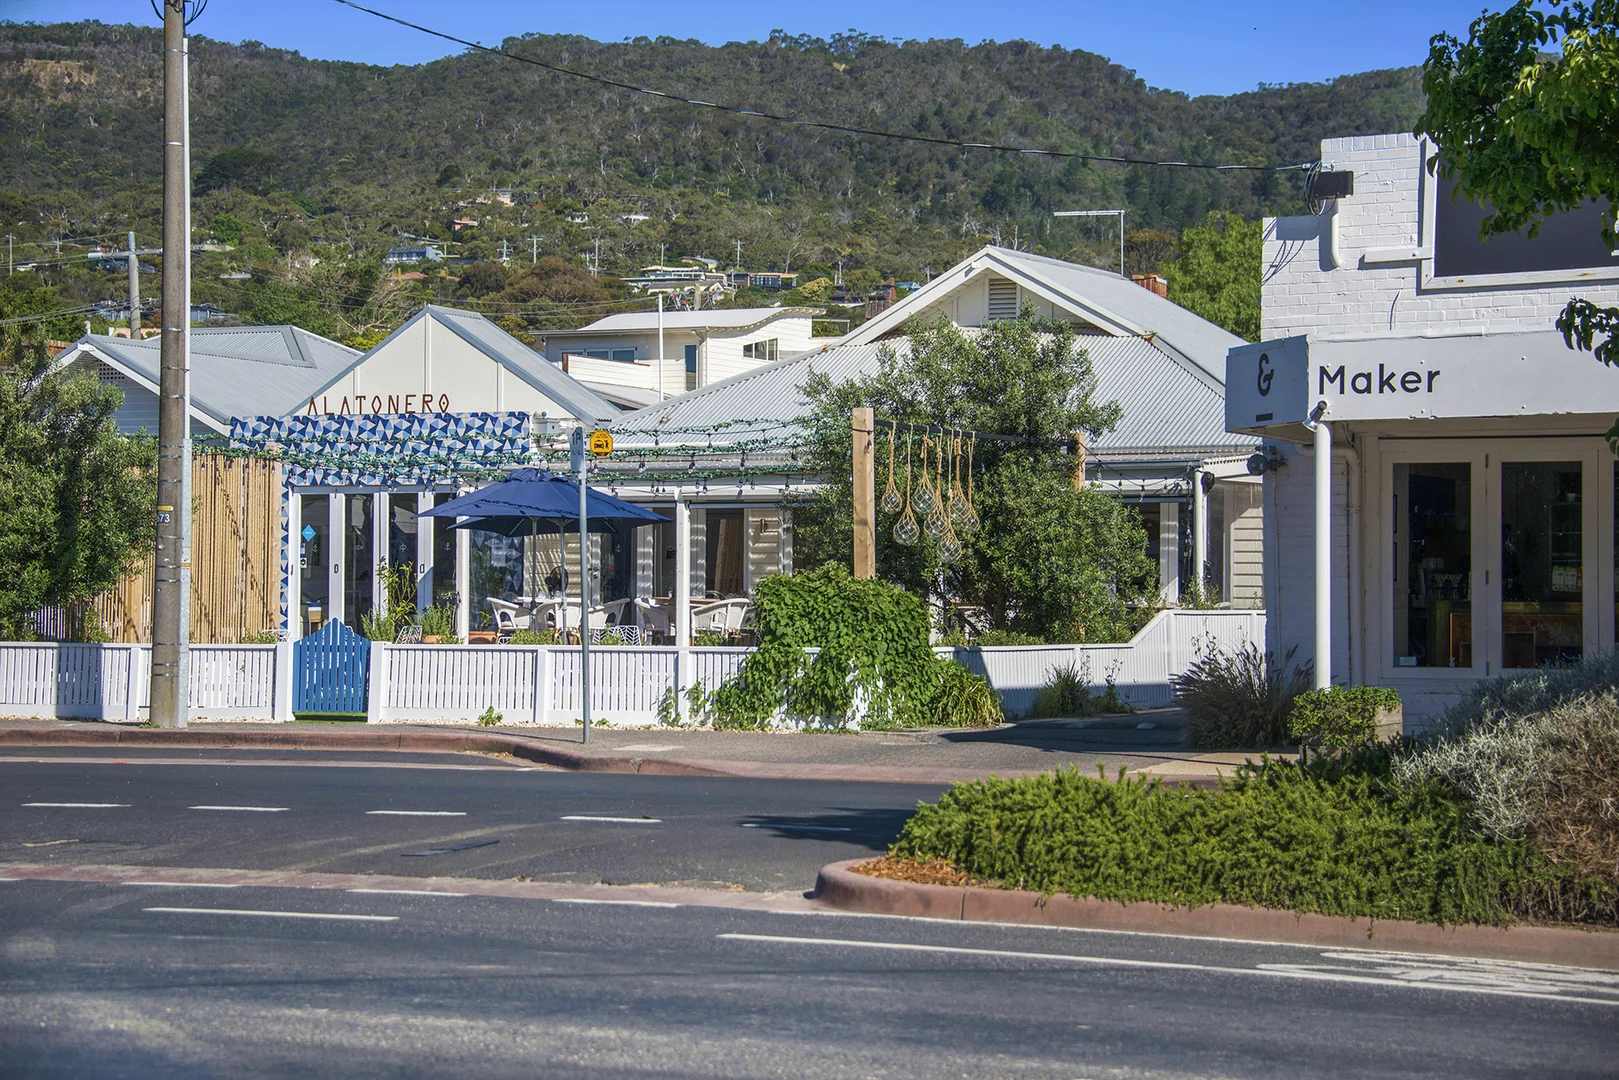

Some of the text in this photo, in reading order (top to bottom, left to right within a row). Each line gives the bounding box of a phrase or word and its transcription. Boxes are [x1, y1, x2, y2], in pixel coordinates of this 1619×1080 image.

[1257, 352, 1275, 397] &
[1318, 363, 1440, 395] Maker
[308, 393, 450, 415] ALATONERO
